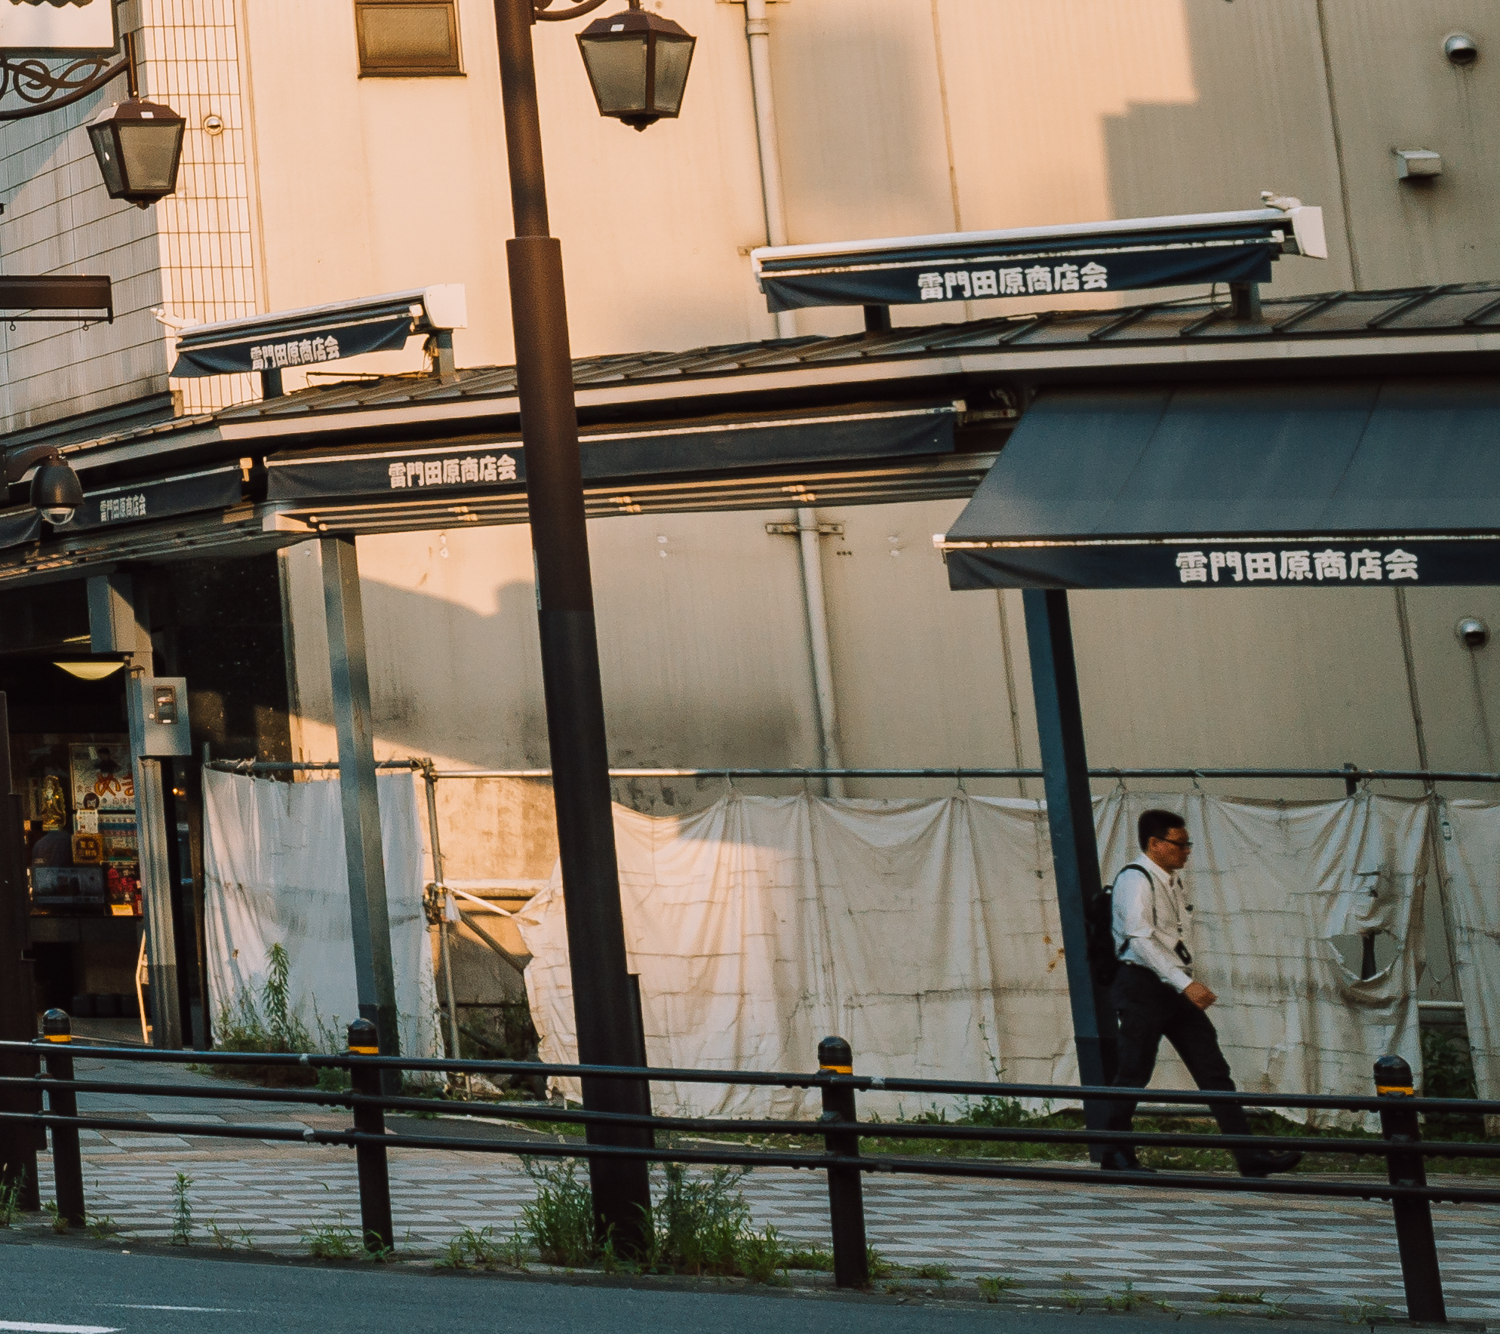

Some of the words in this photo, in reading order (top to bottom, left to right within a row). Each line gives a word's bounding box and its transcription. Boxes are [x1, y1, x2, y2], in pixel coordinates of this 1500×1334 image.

[917, 261, 1108, 301] 雷門田原商店会
[250, 335, 340, 371] 雷門田原商店会
[388, 453, 517, 489] 雷門田原商店会
[1175, 548, 1419, 584] 雷門田原商店会
